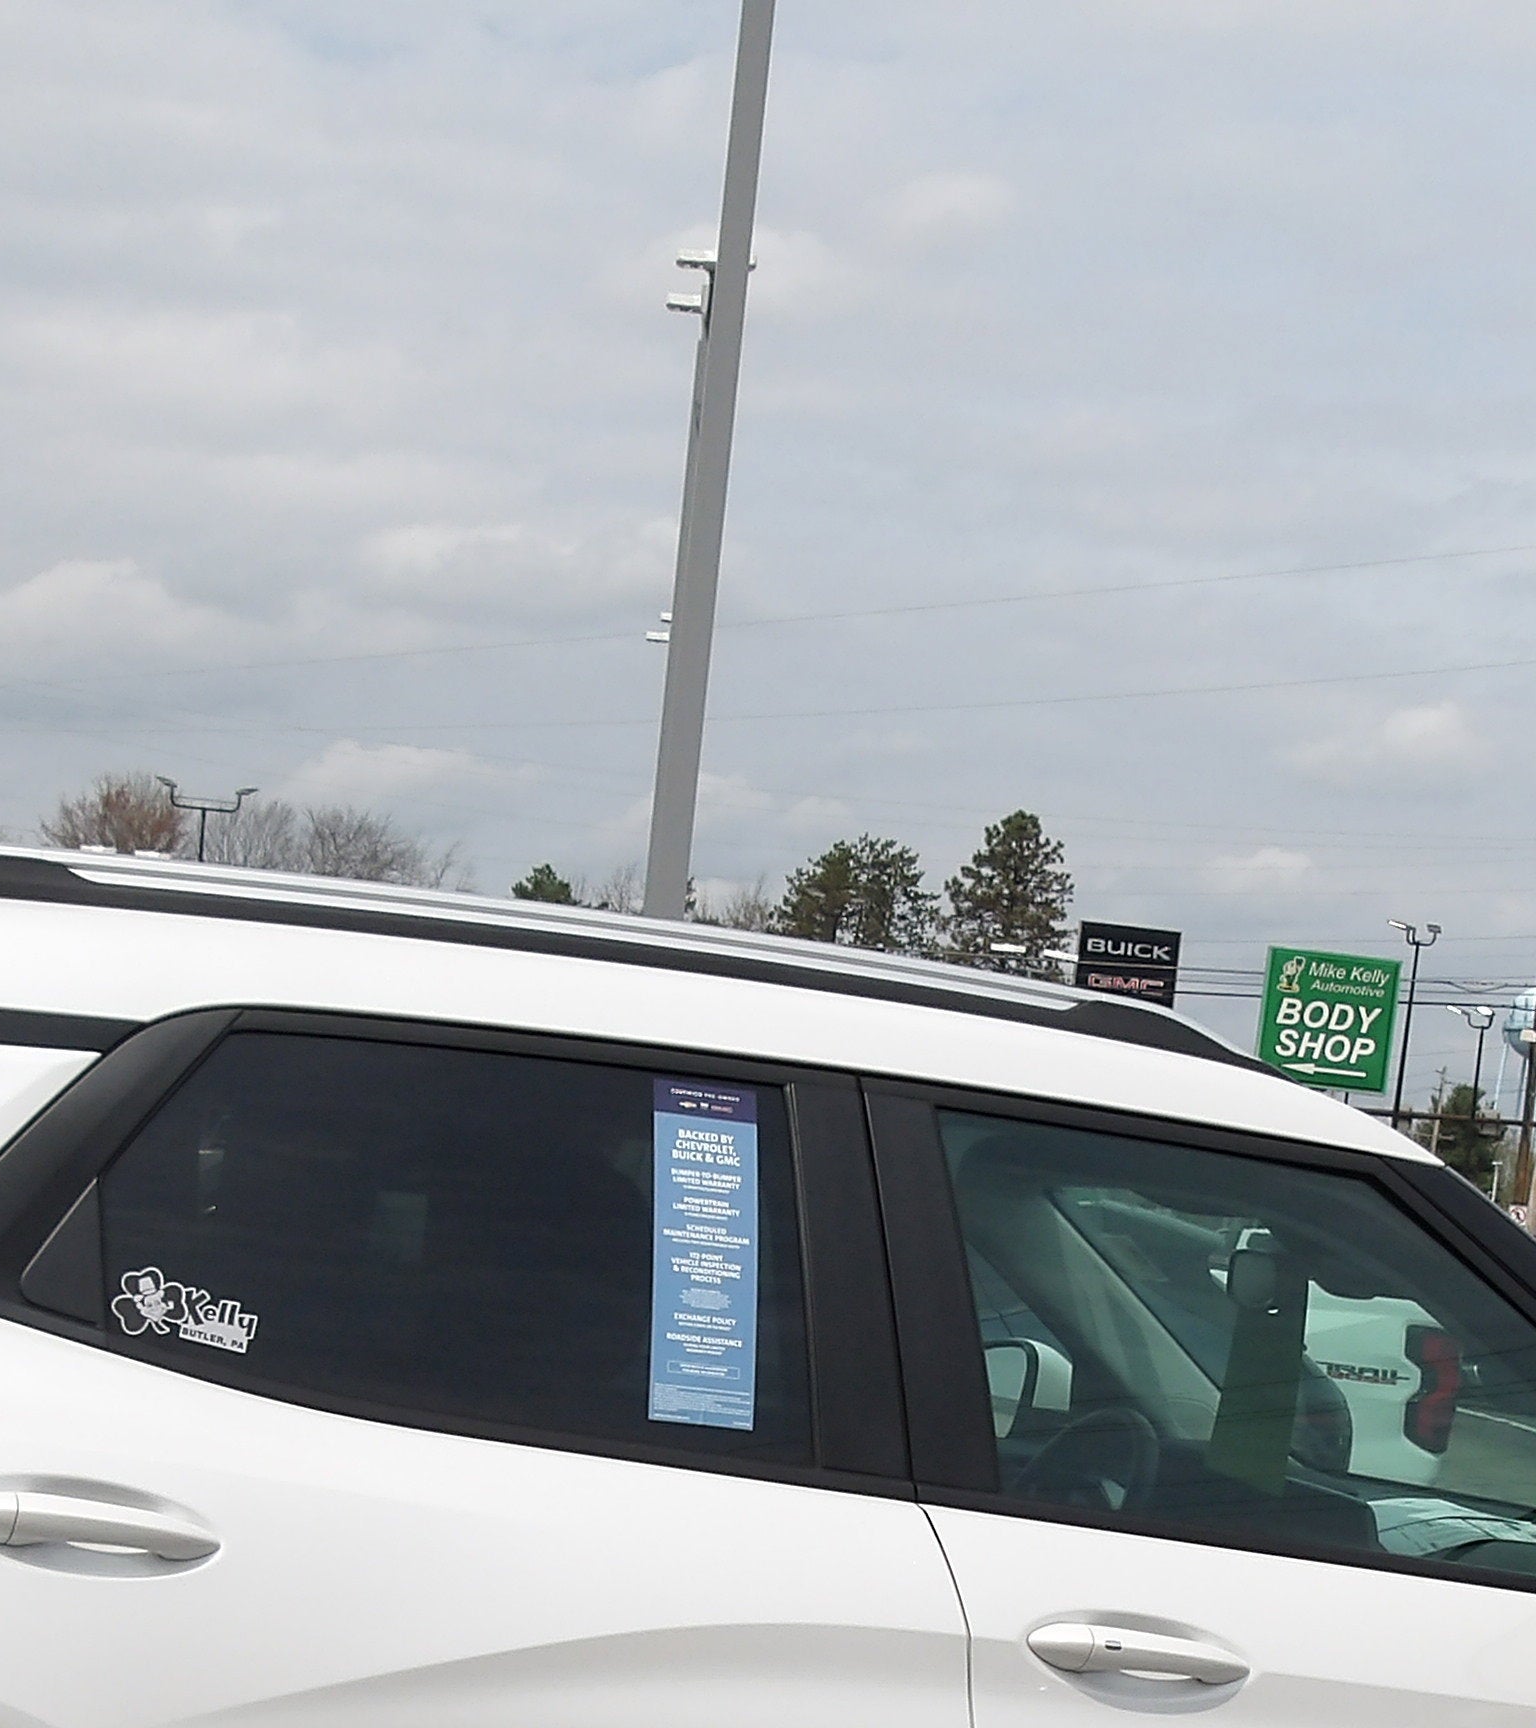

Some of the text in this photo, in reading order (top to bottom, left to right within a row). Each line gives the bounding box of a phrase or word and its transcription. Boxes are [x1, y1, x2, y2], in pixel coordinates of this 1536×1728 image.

[1087, 937, 1172, 960] BUICK
[1088, 973, 1164, 996] GMC
[1309, 962, 1390, 987] Mike Kelly
[1310, 979, 1385, 998] Automotive
[1275, 997, 1383, 1034] BODY
[1275, 1029, 1376, 1064] SHOP
[676, 1140, 737, 1156] CHEVROLET,
[678, 1128, 734, 1145] BACKED BY
[672, 1149, 740, 1167] BUICK & GMC
[715, 1235, 750, 1245] PROGRAM
[184, 1288, 257, 1338] Kelly
[182, 1327, 245, 1350] BUTLER, PA
[702, 1337, 743, 1348] ASSISTANCE
